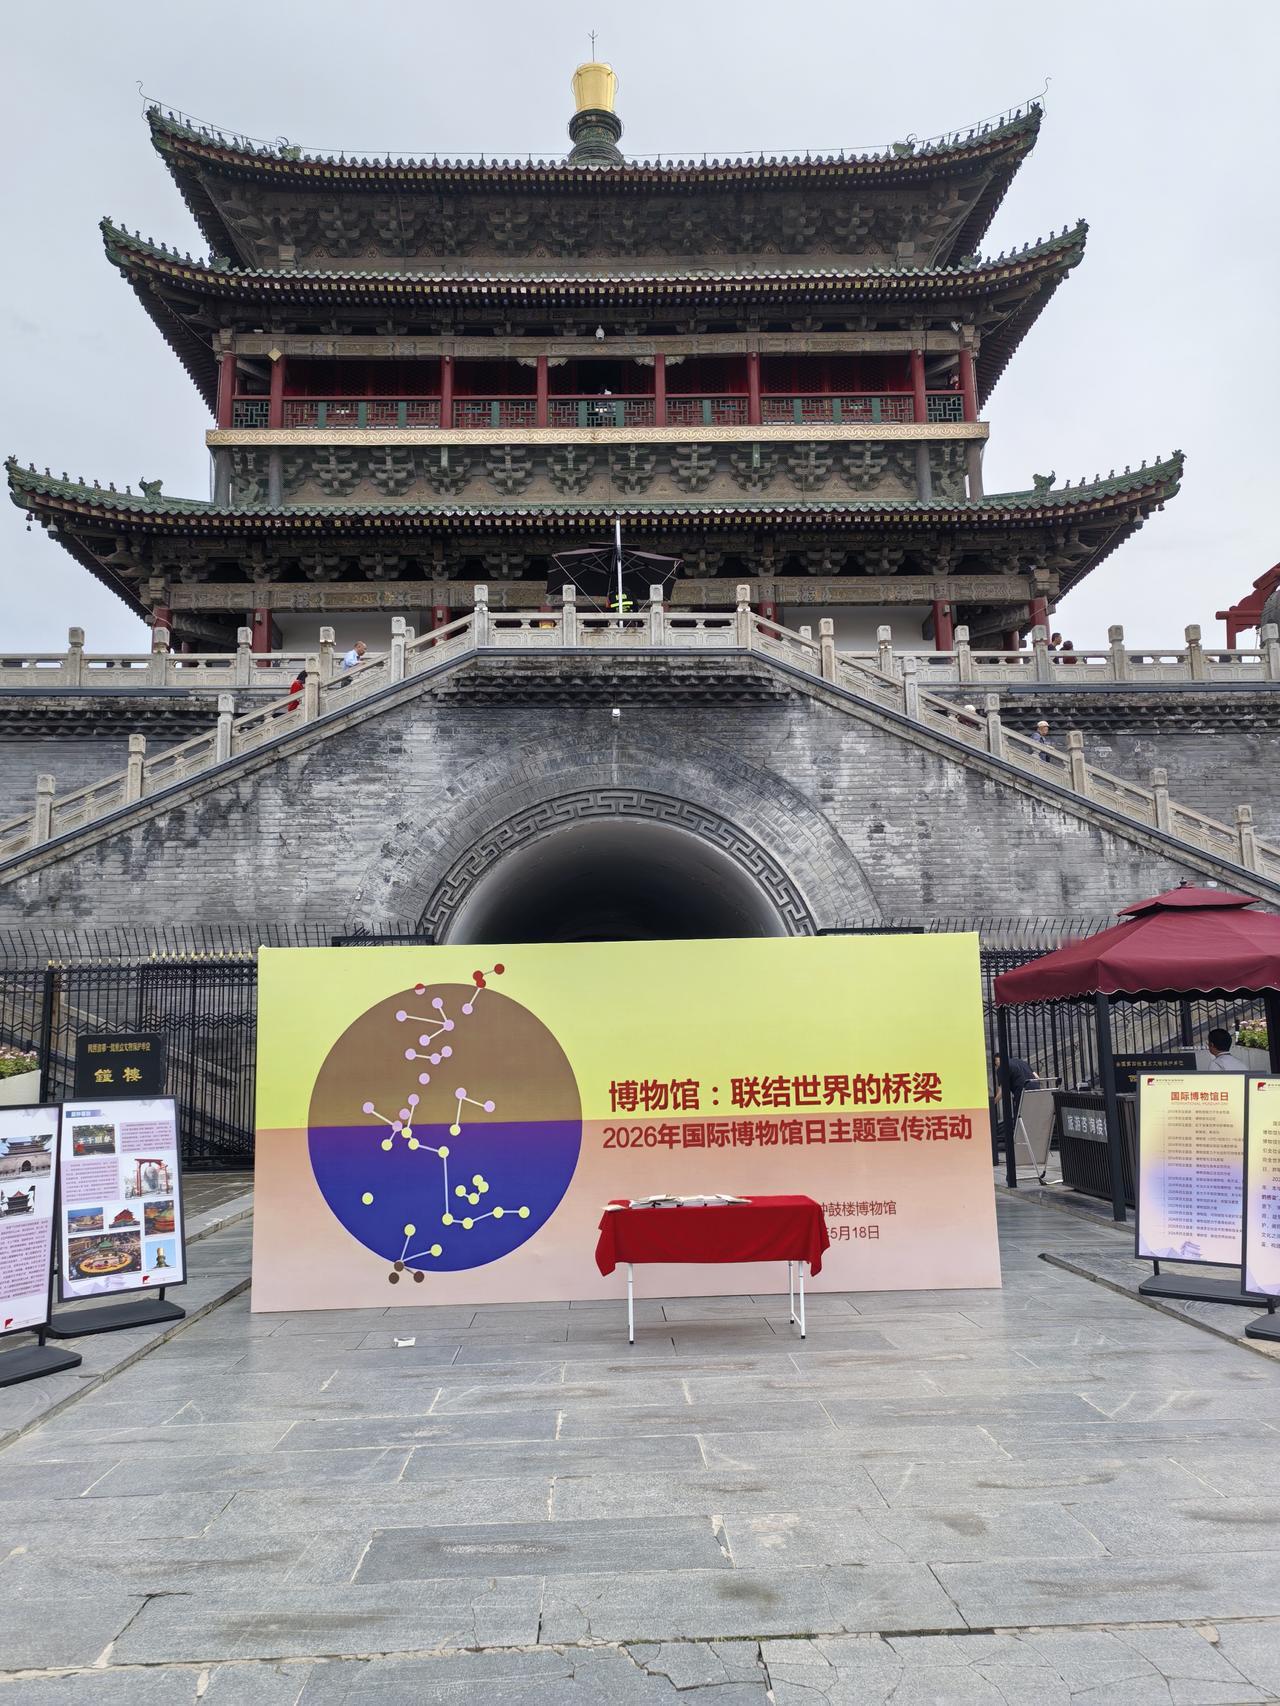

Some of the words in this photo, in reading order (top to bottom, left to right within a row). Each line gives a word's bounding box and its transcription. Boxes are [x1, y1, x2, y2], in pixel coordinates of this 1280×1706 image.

[609, 1072, 942, 1112] 博物馆：联结世界的桥梁
[1171, 1091, 1228, 1101] 国际博物馆日
[603, 1114, 972, 1149] 2026年国际博物馆日主题宣传活动
[827, 1225, 880, 1240] 5月18日
